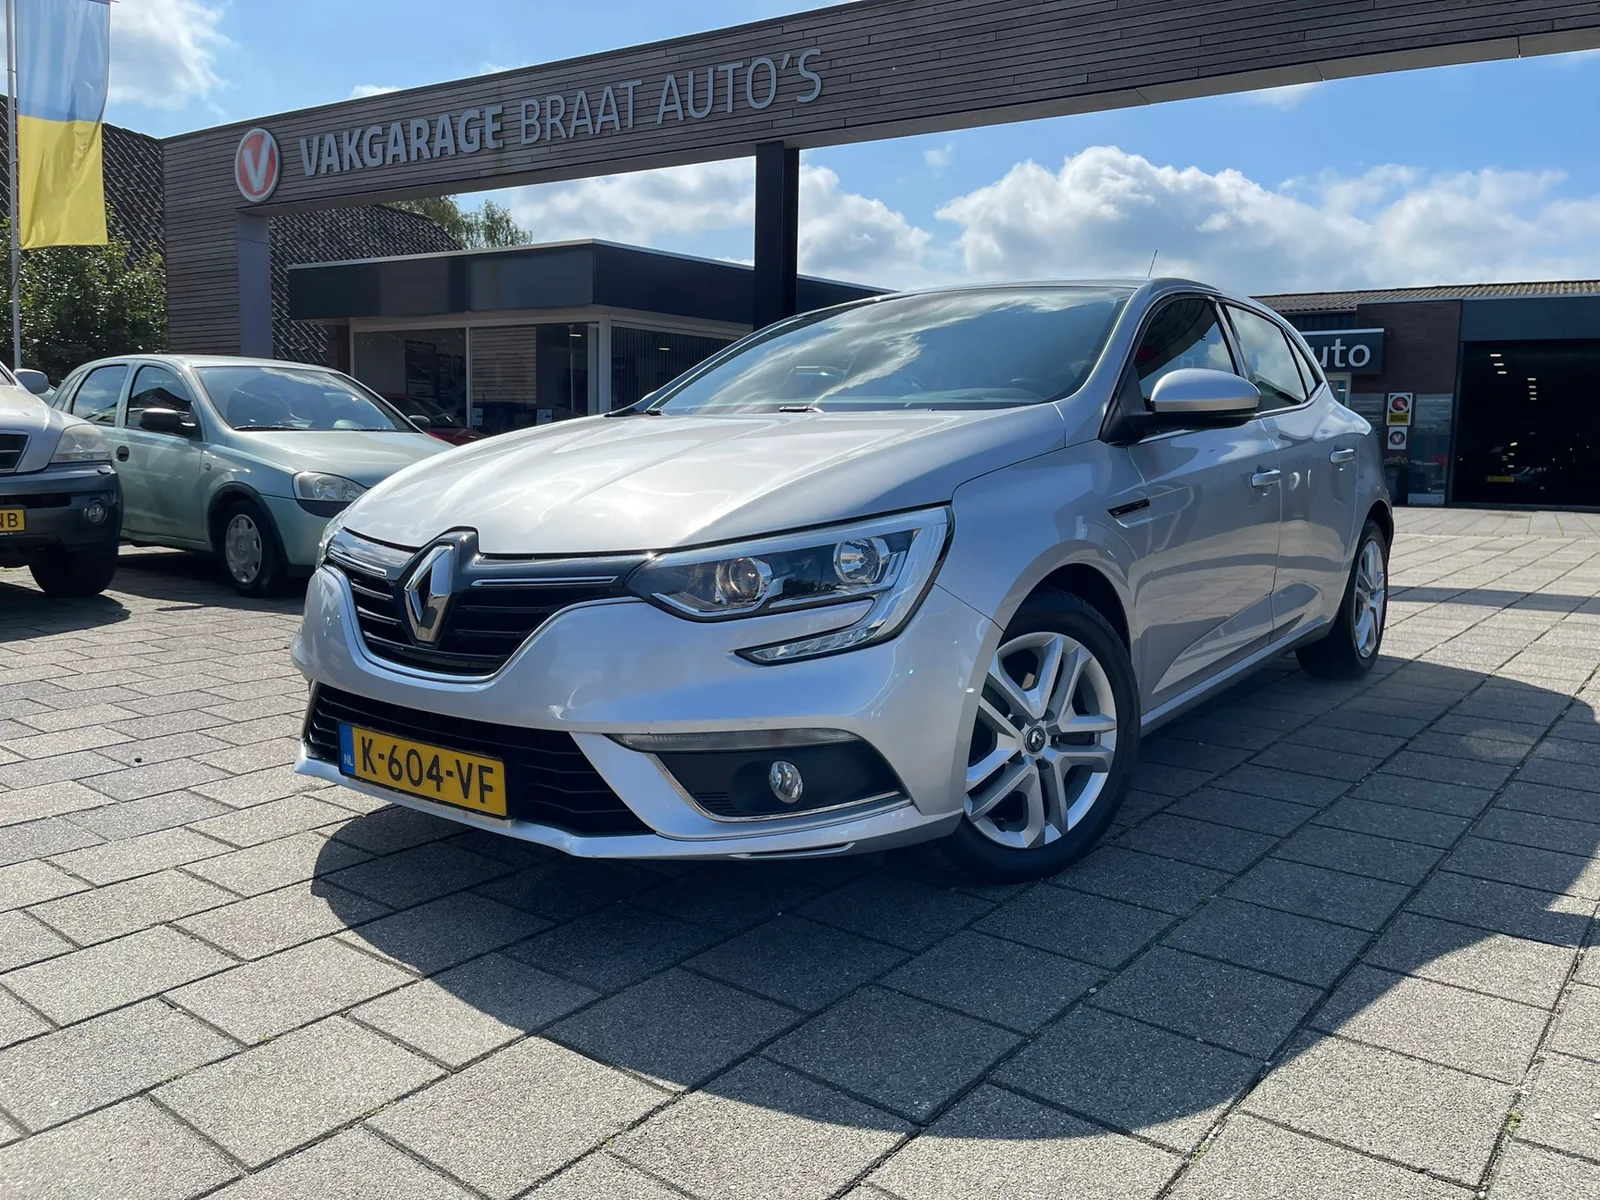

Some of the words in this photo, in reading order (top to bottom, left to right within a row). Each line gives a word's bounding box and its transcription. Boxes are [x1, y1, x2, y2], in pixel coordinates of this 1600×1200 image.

[300, 105, 504, 176] VAKGARAGE
[520, 80, 643, 145] BRAAT
[656, 49, 822, 125] AUTO'S
[243, 133, 272, 192] V
[343, 753, 354, 767] NL
[361, 736, 494, 803] K-604-VF
